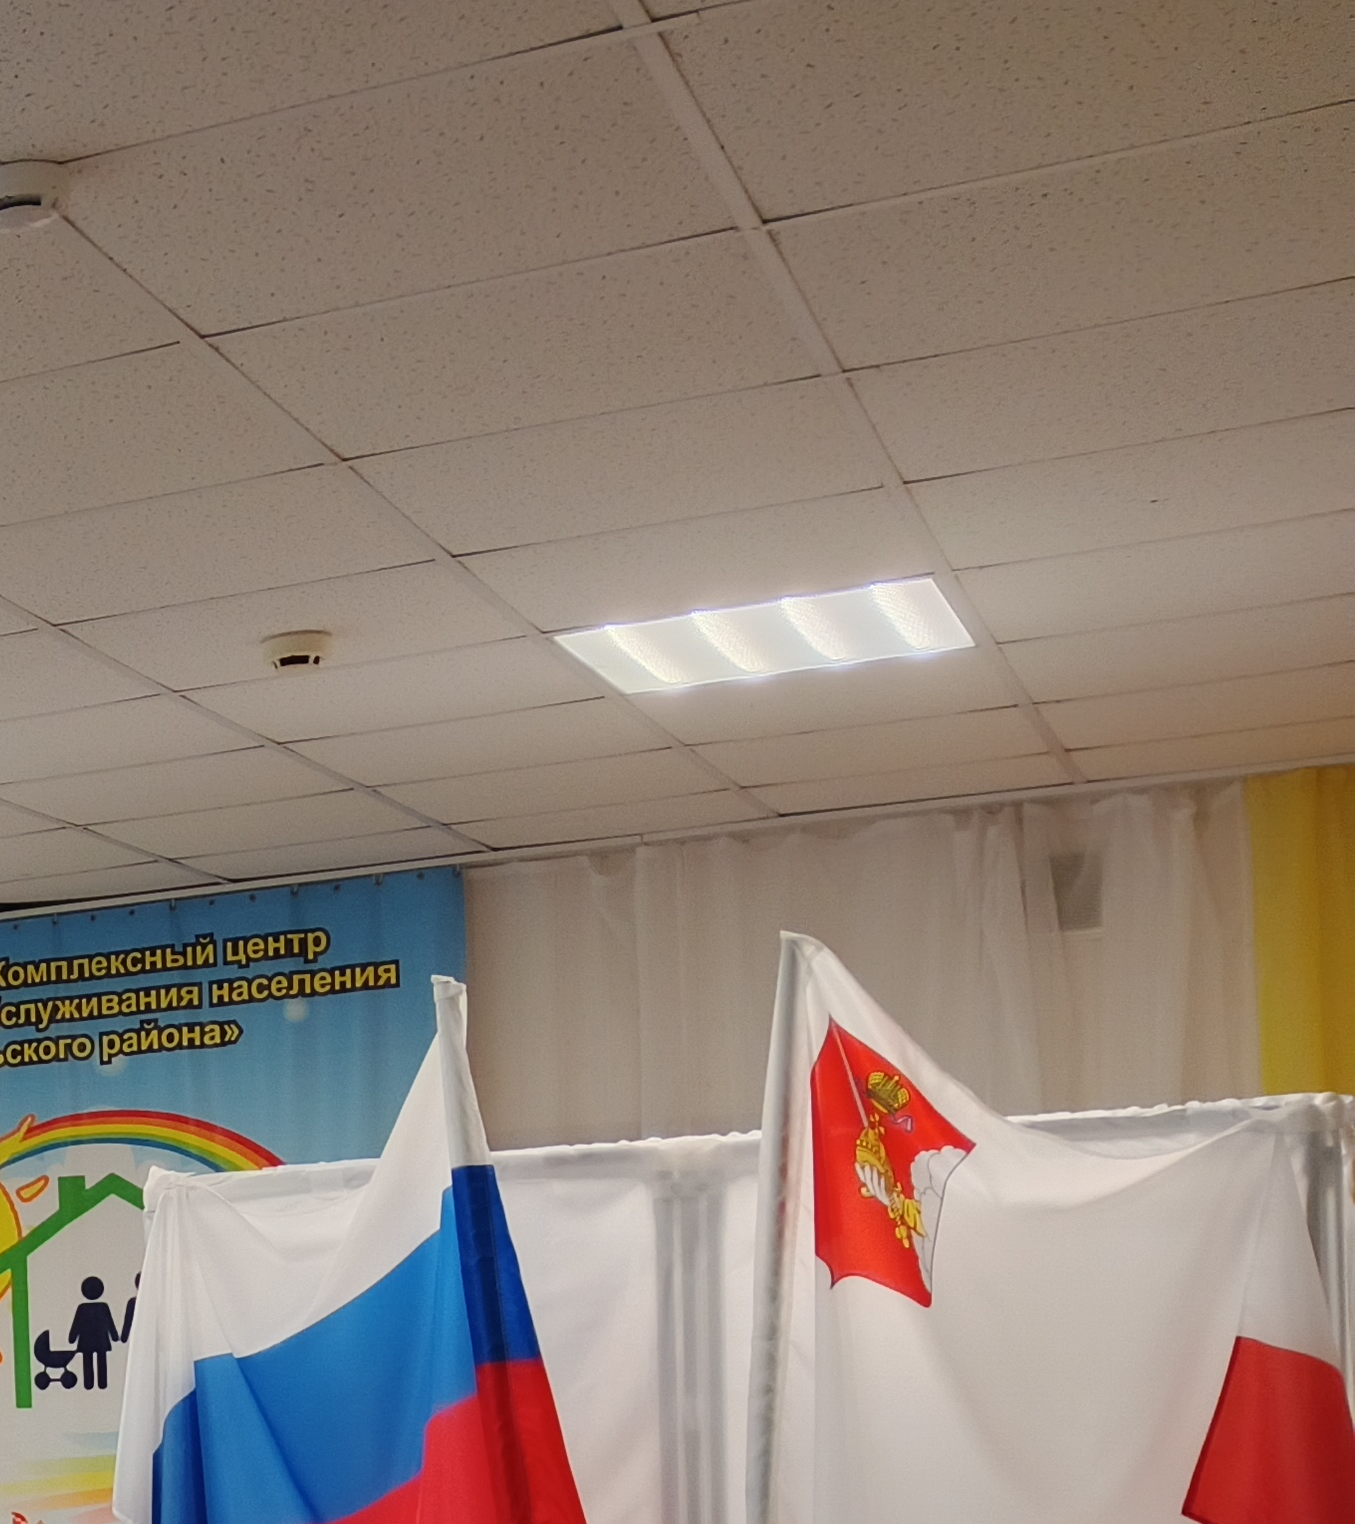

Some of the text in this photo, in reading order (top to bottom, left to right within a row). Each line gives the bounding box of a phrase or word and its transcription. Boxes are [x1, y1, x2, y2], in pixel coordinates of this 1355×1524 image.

[225, 929, 329, 966] центр
[211, 963, 398, 1004] населения
[101, 1022, 242, 1062] района»
